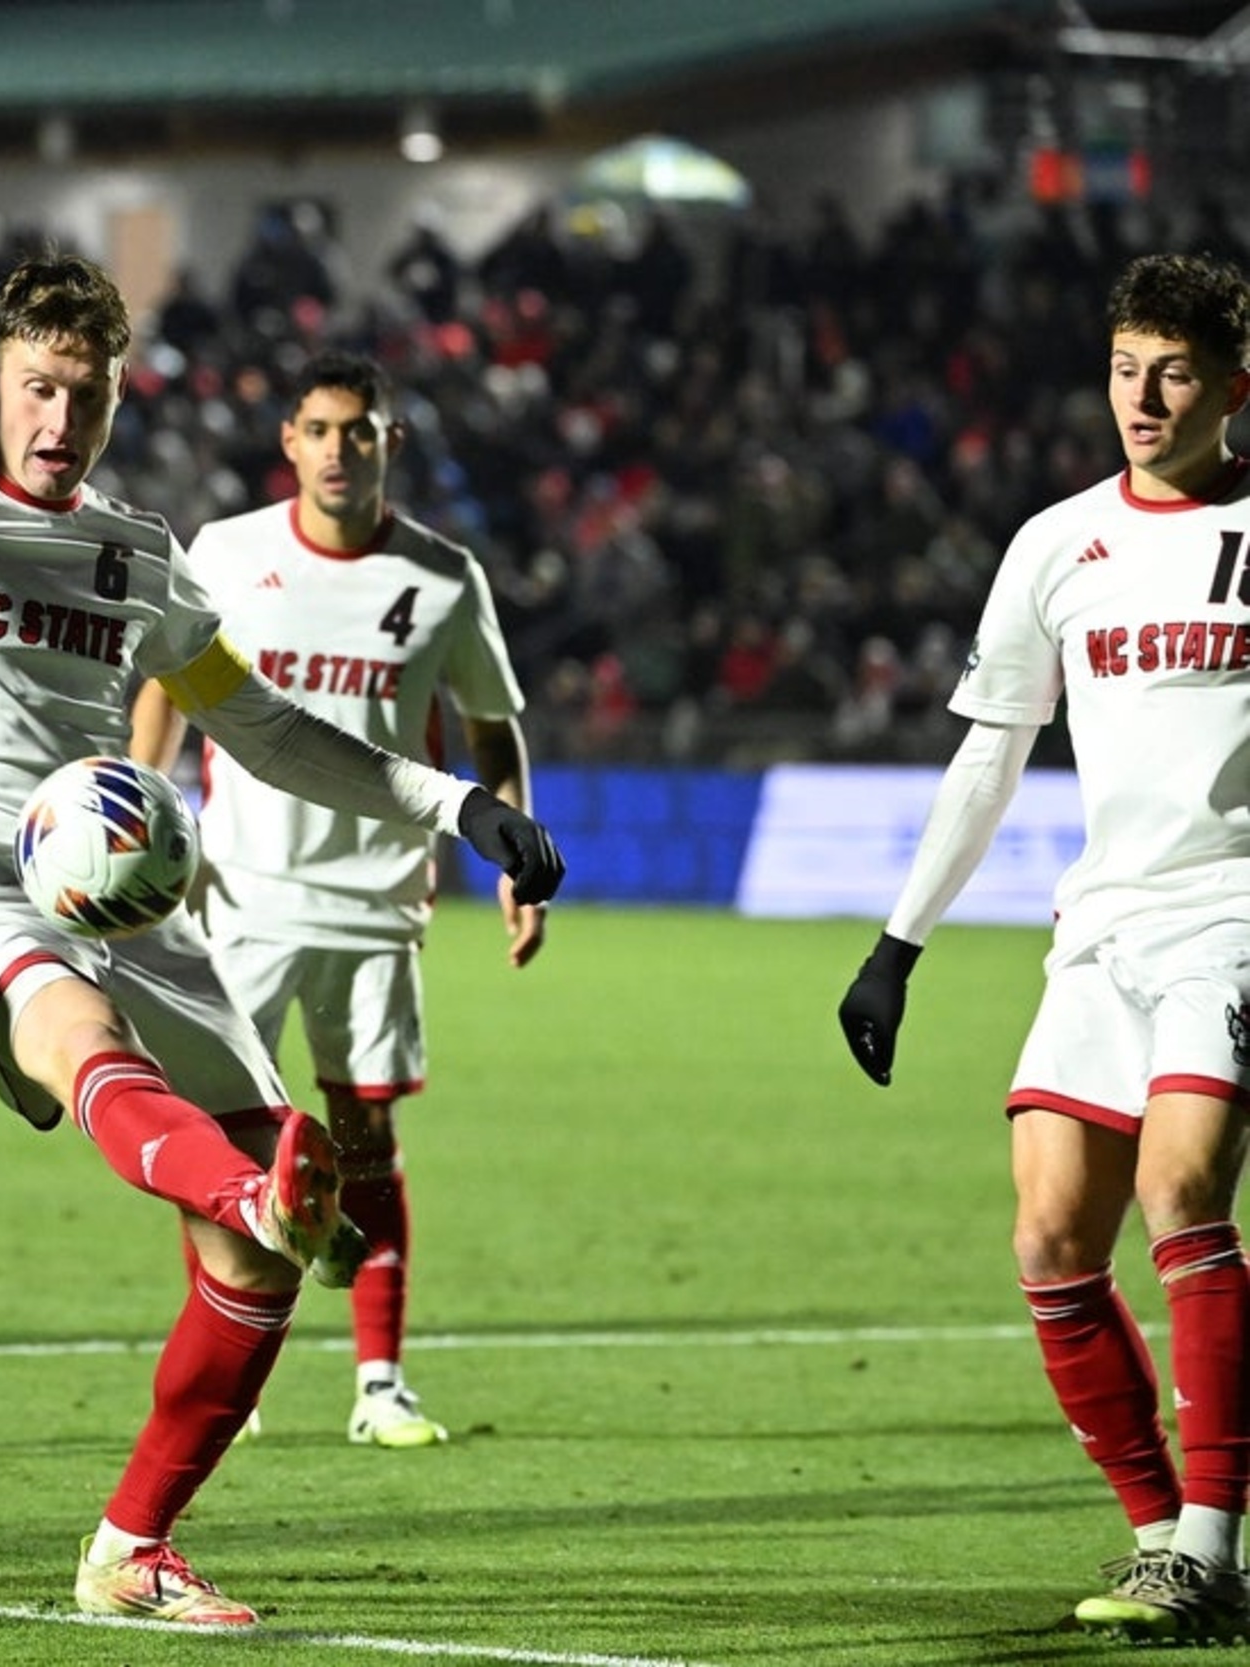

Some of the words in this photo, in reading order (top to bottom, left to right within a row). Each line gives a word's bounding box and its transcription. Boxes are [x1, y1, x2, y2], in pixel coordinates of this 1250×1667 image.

[94, 541, 134, 602] 6
[18, 600, 127, 667] STATE
[378, 586, 420, 647] 4
[259, 649, 298, 689] NC
[303, 653, 406, 699] STATE
[1086, 627, 1128, 678] NC
[1137, 621, 1250, 672] STATE
